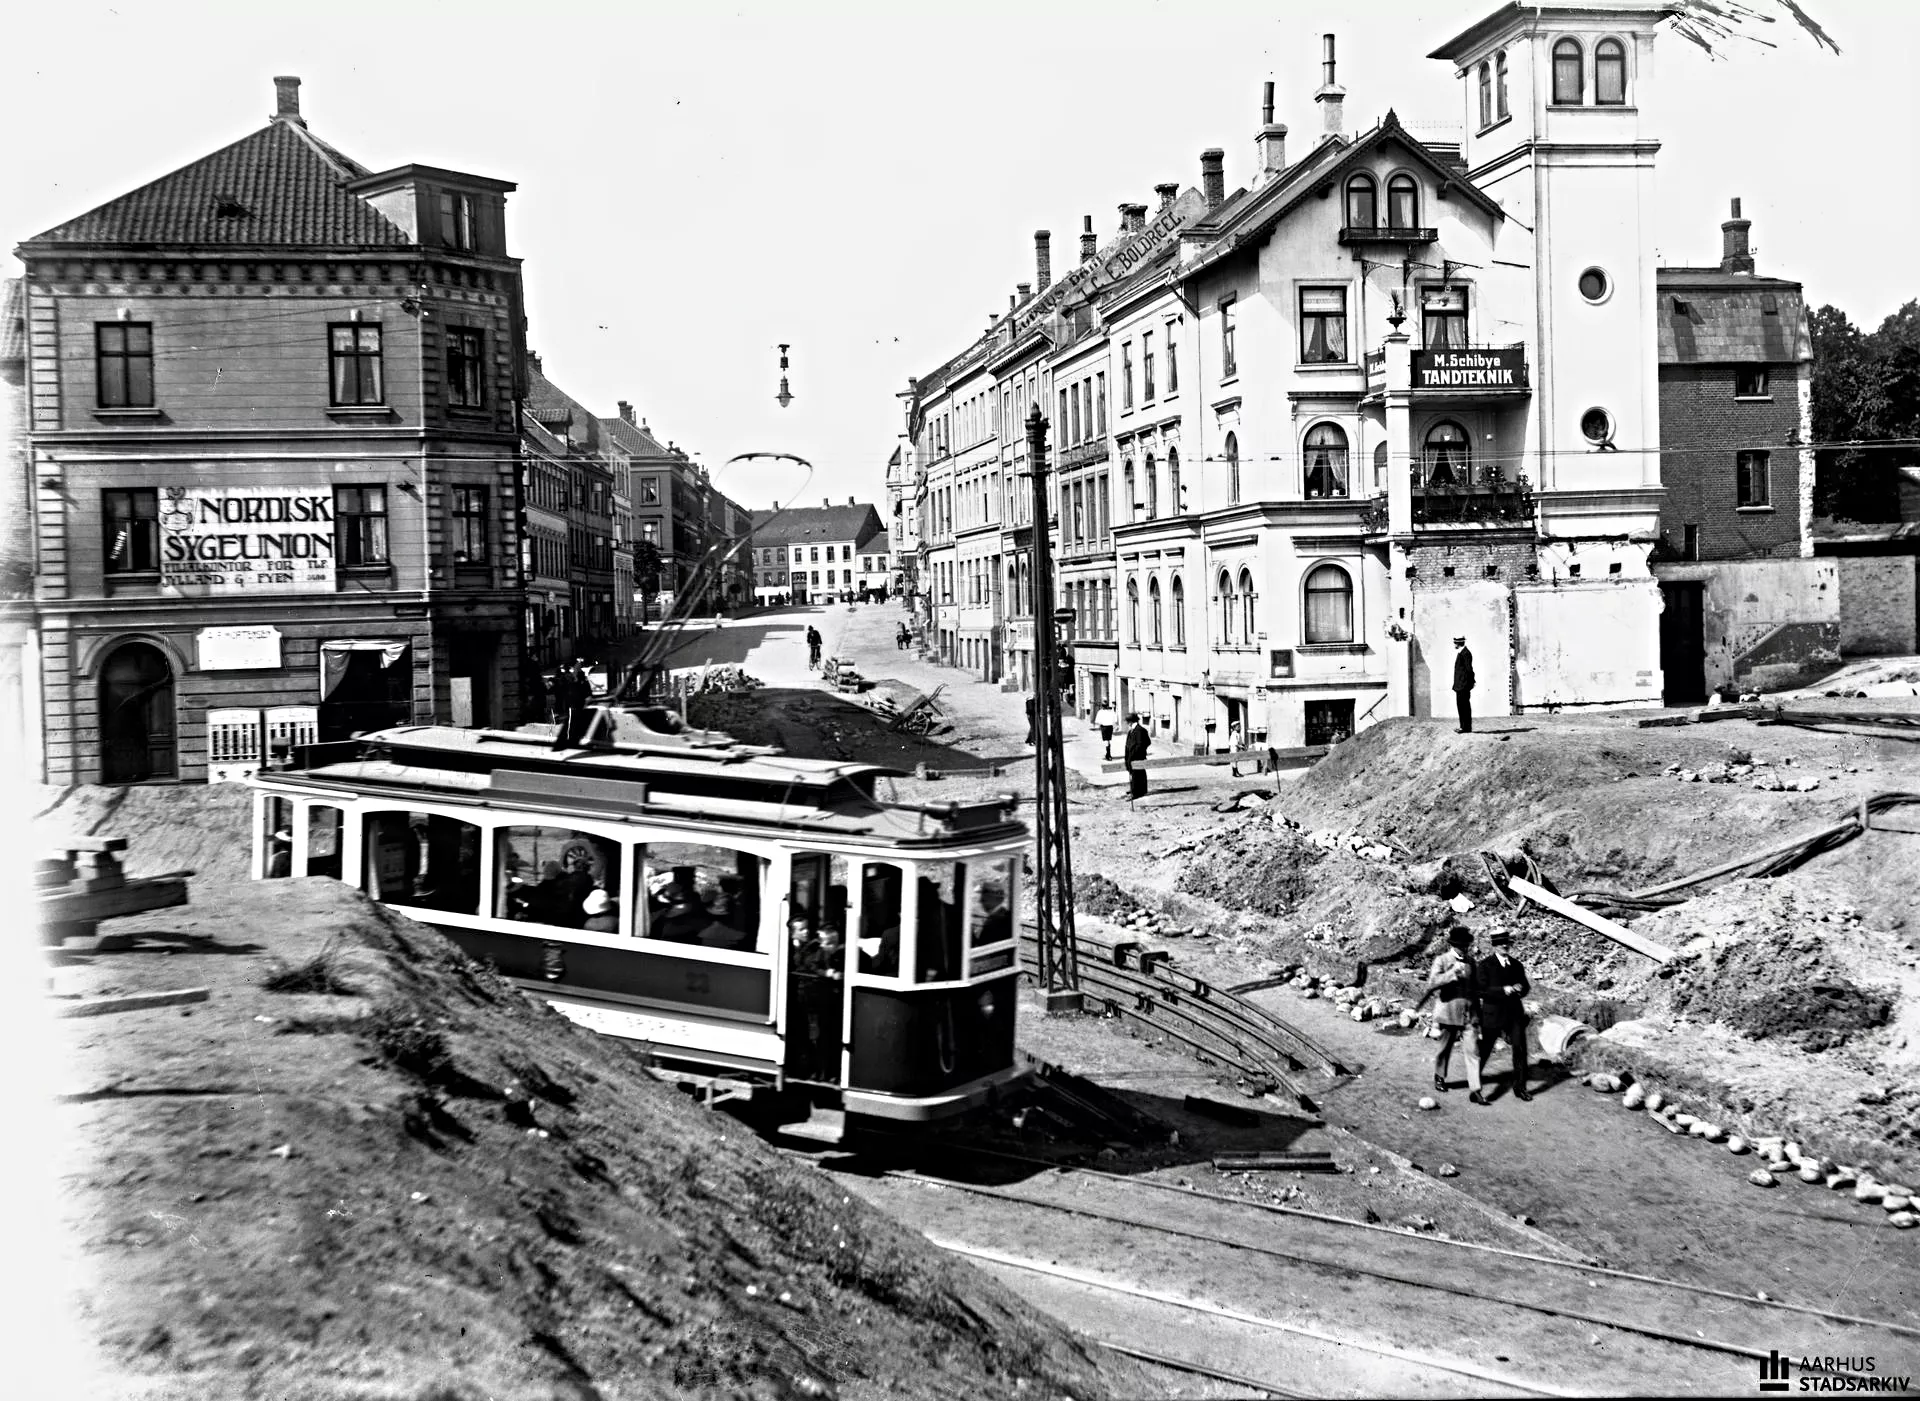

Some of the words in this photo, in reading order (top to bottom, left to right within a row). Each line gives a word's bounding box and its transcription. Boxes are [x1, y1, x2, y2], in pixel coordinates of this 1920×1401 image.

[1422, 369, 1514, 385] TANDTEKNIK
[199, 496, 334, 524] NORDISK
[164, 533, 335, 561] SYGEUNION
[266, 560, 295, 571] FOR
[162, 574, 225, 588] JYLLAND
[257, 573, 294, 584] FYEN
